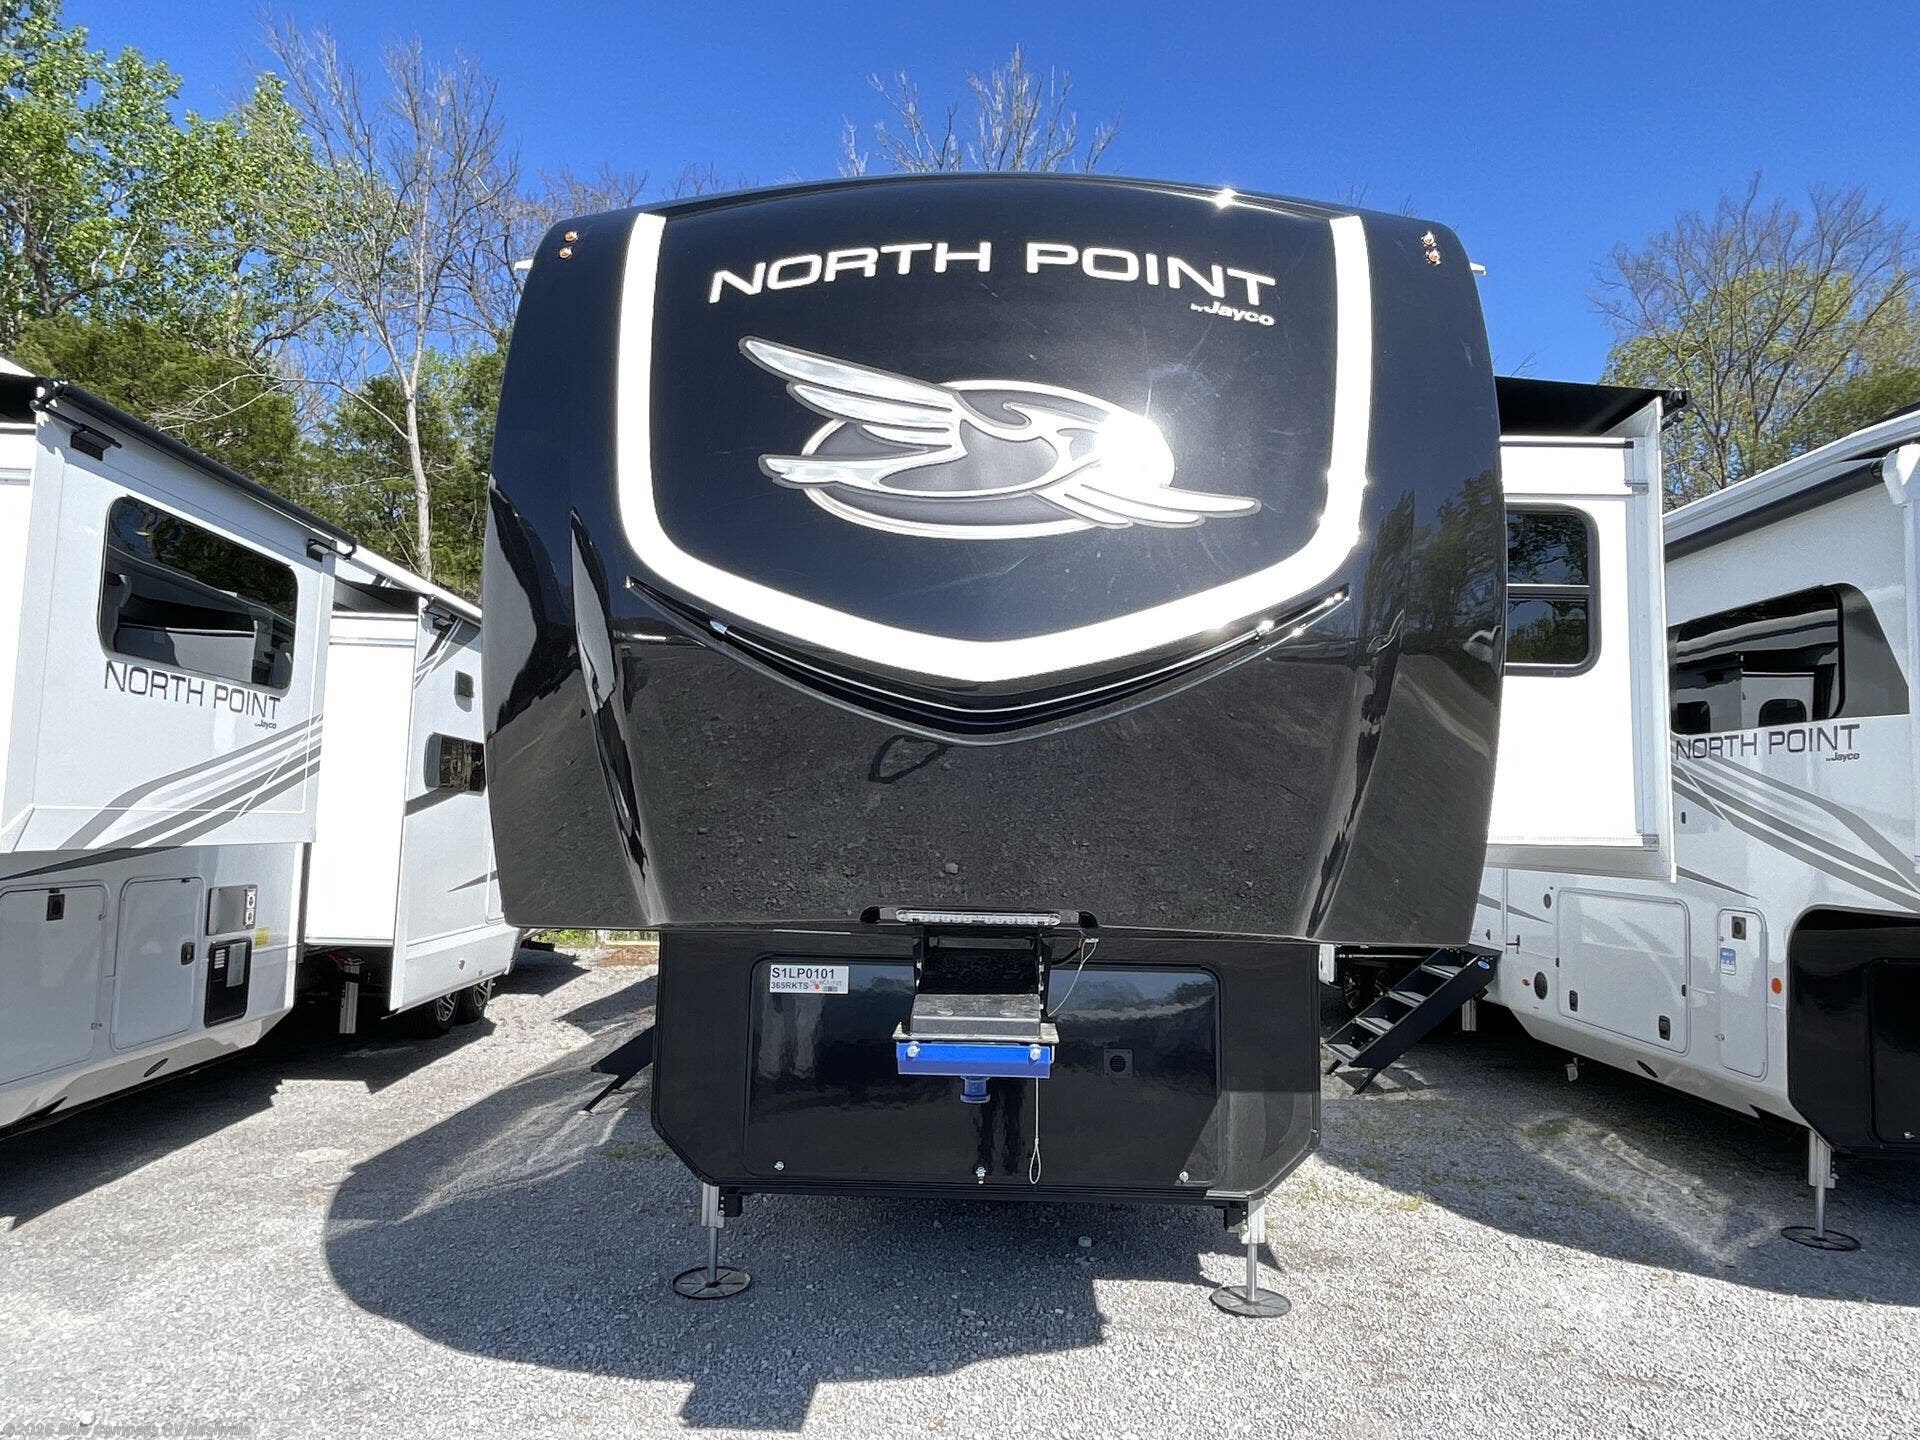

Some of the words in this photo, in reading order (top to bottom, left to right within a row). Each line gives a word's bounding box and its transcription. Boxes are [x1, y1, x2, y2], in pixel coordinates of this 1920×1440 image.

[708, 241, 992, 304] NORTH
[1026, 241, 1276, 306] POINT
[1203, 301, 1276, 326] Jayco
[104, 660, 205, 707] NORTH
[213, 684, 281, 720] POINT
[1675, 732, 1758, 760] NORTH
[1768, 723, 1860, 755] POINT
[1830, 752, 1860, 763] Jayco
[770, 981, 809, 990] 365RKTS
[771, 967, 835, 979] S1LP0101
